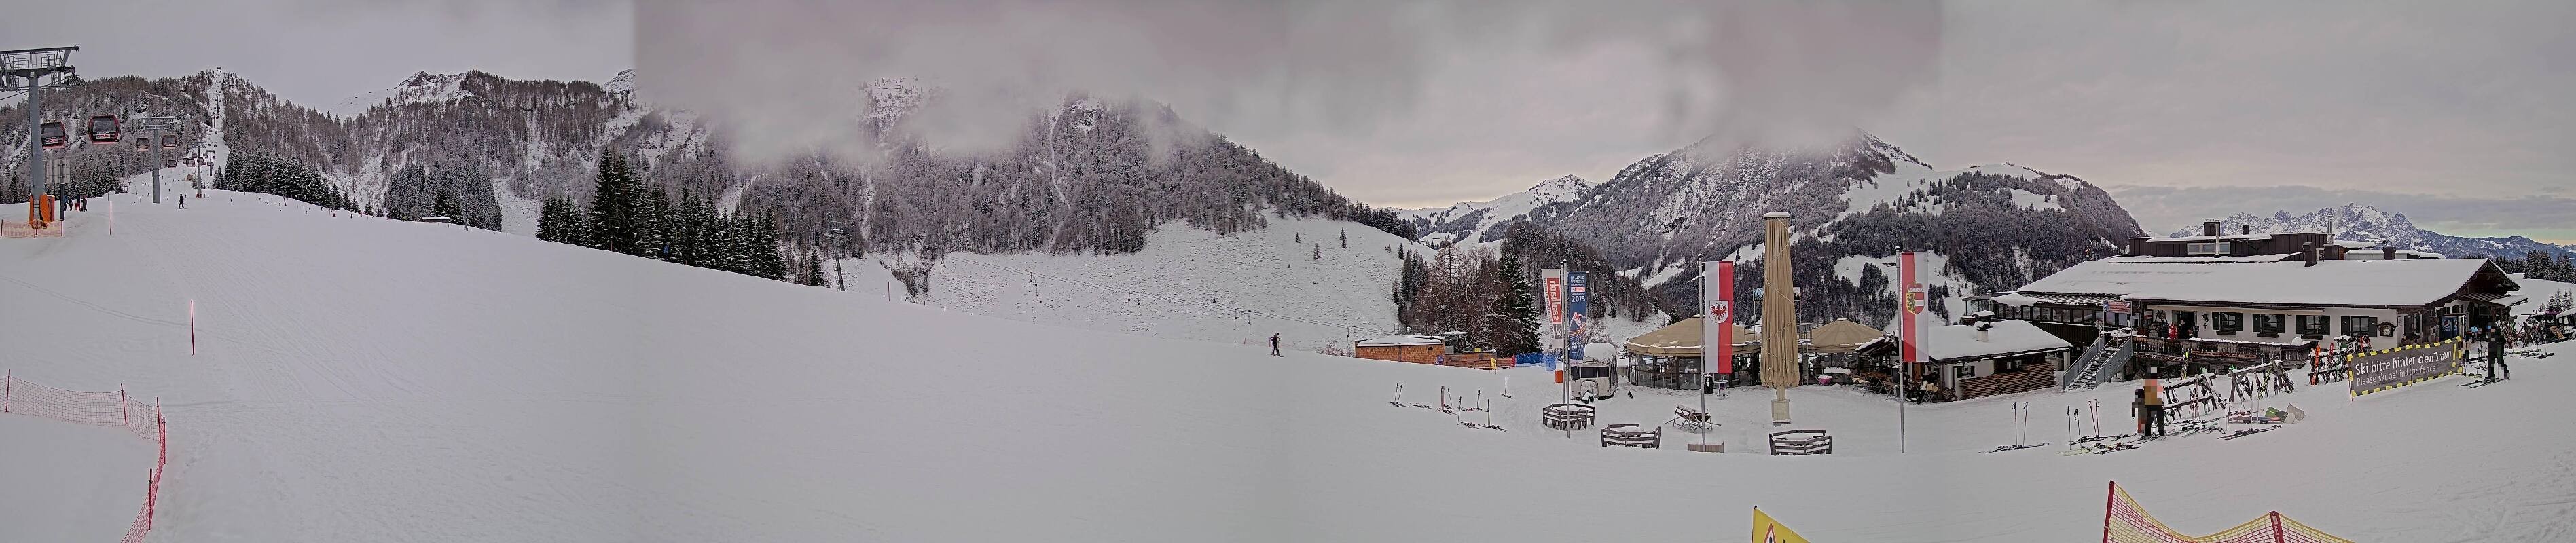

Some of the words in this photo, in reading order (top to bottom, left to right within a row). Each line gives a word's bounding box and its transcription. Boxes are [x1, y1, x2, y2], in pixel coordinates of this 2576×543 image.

[2355, 362, 2368, 375] Ski
[2371, 360, 2391, 373] bitte
[2393, 356, 2416, 369] hinter
[2418, 353, 2434, 364] den
[2356, 376, 2377, 386] Please
[2378, 373, 2387, 382] ski
[2388, 368, 2408, 379] behind
[2419, 365, 2436, 373] fence
